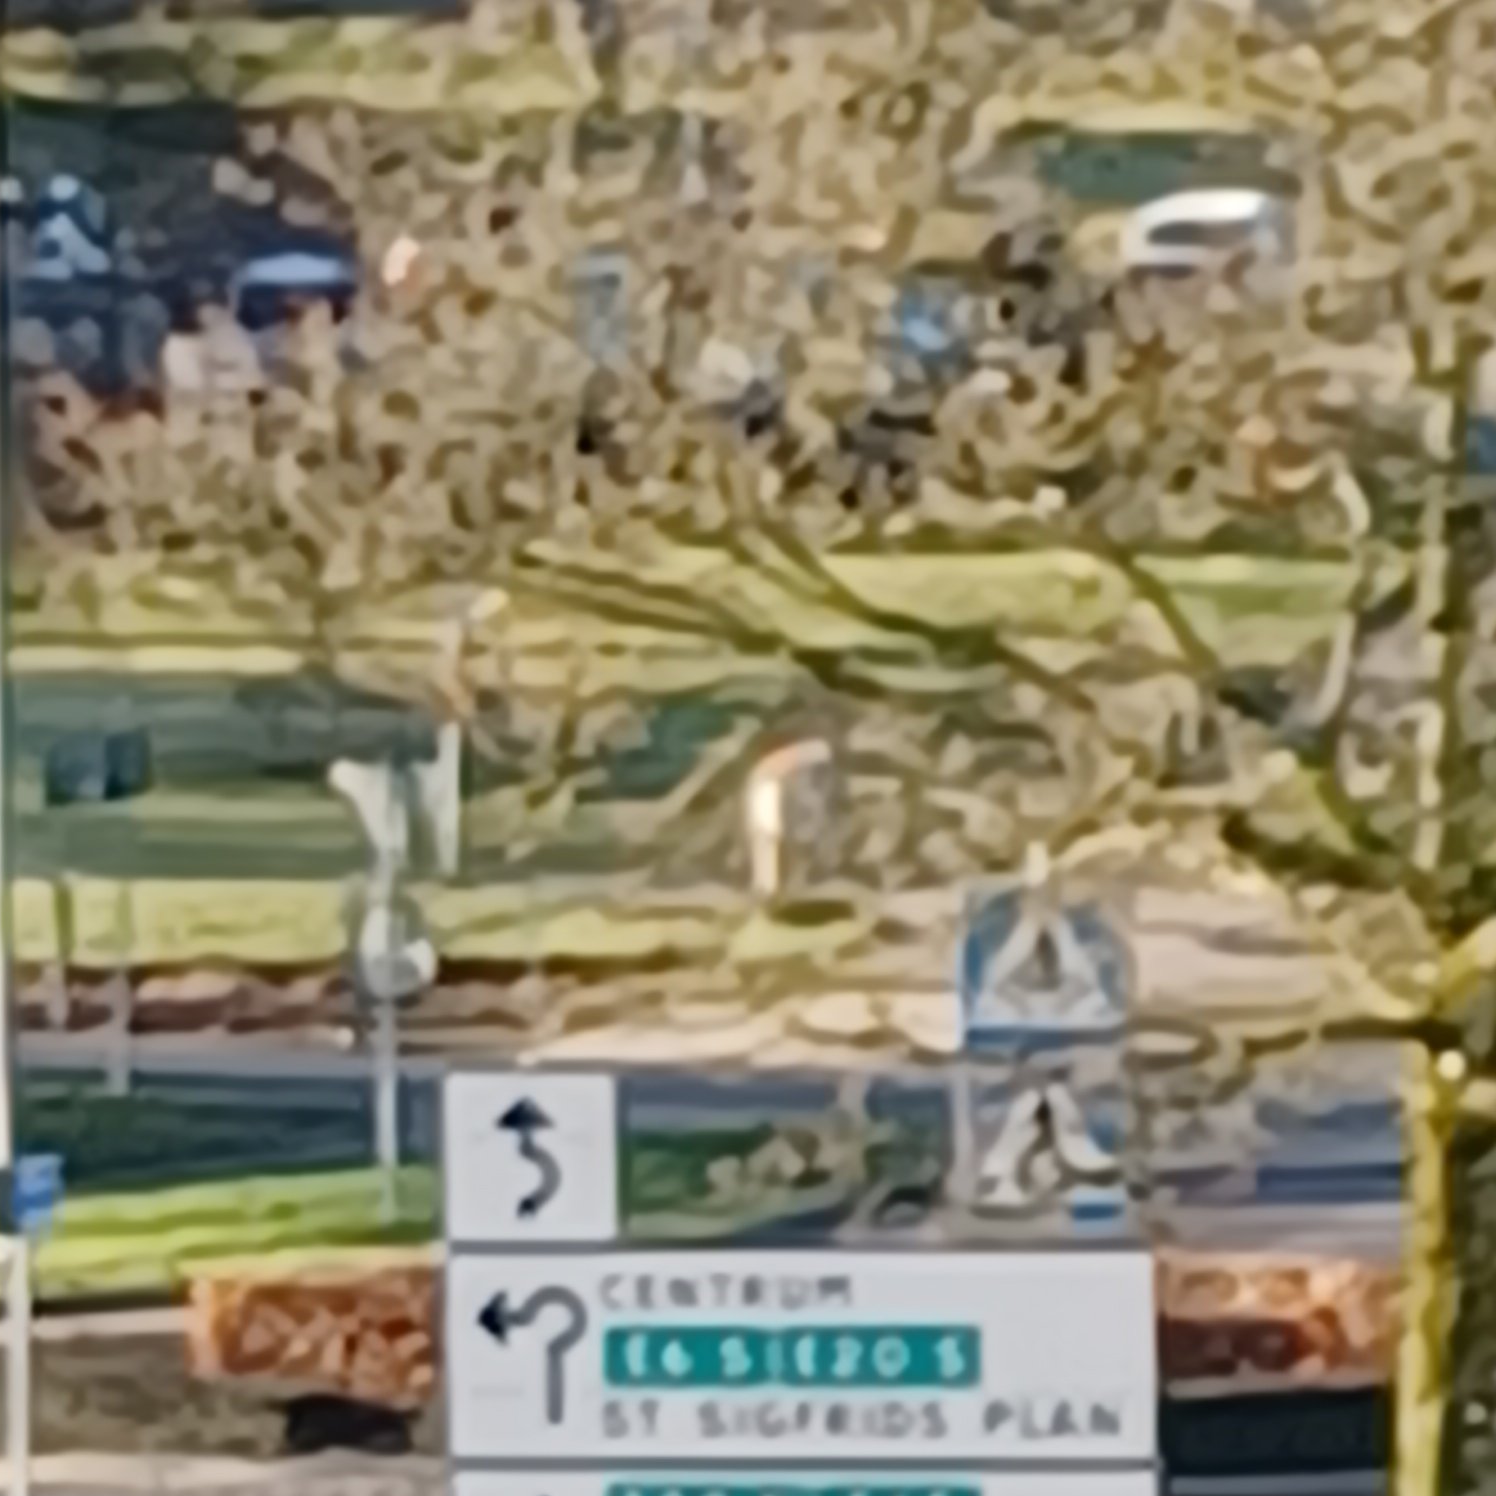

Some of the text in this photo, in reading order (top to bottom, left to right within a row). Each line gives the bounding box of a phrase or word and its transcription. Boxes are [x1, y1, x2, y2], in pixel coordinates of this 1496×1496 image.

[600, 1273, 851, 1309] CENTRUM
[624, 1333, 693, 1377] E6
[794, 1333, 911, 1378] E20
[602, 1400, 1121, 1438] ST SIGFRIDS PLAN
